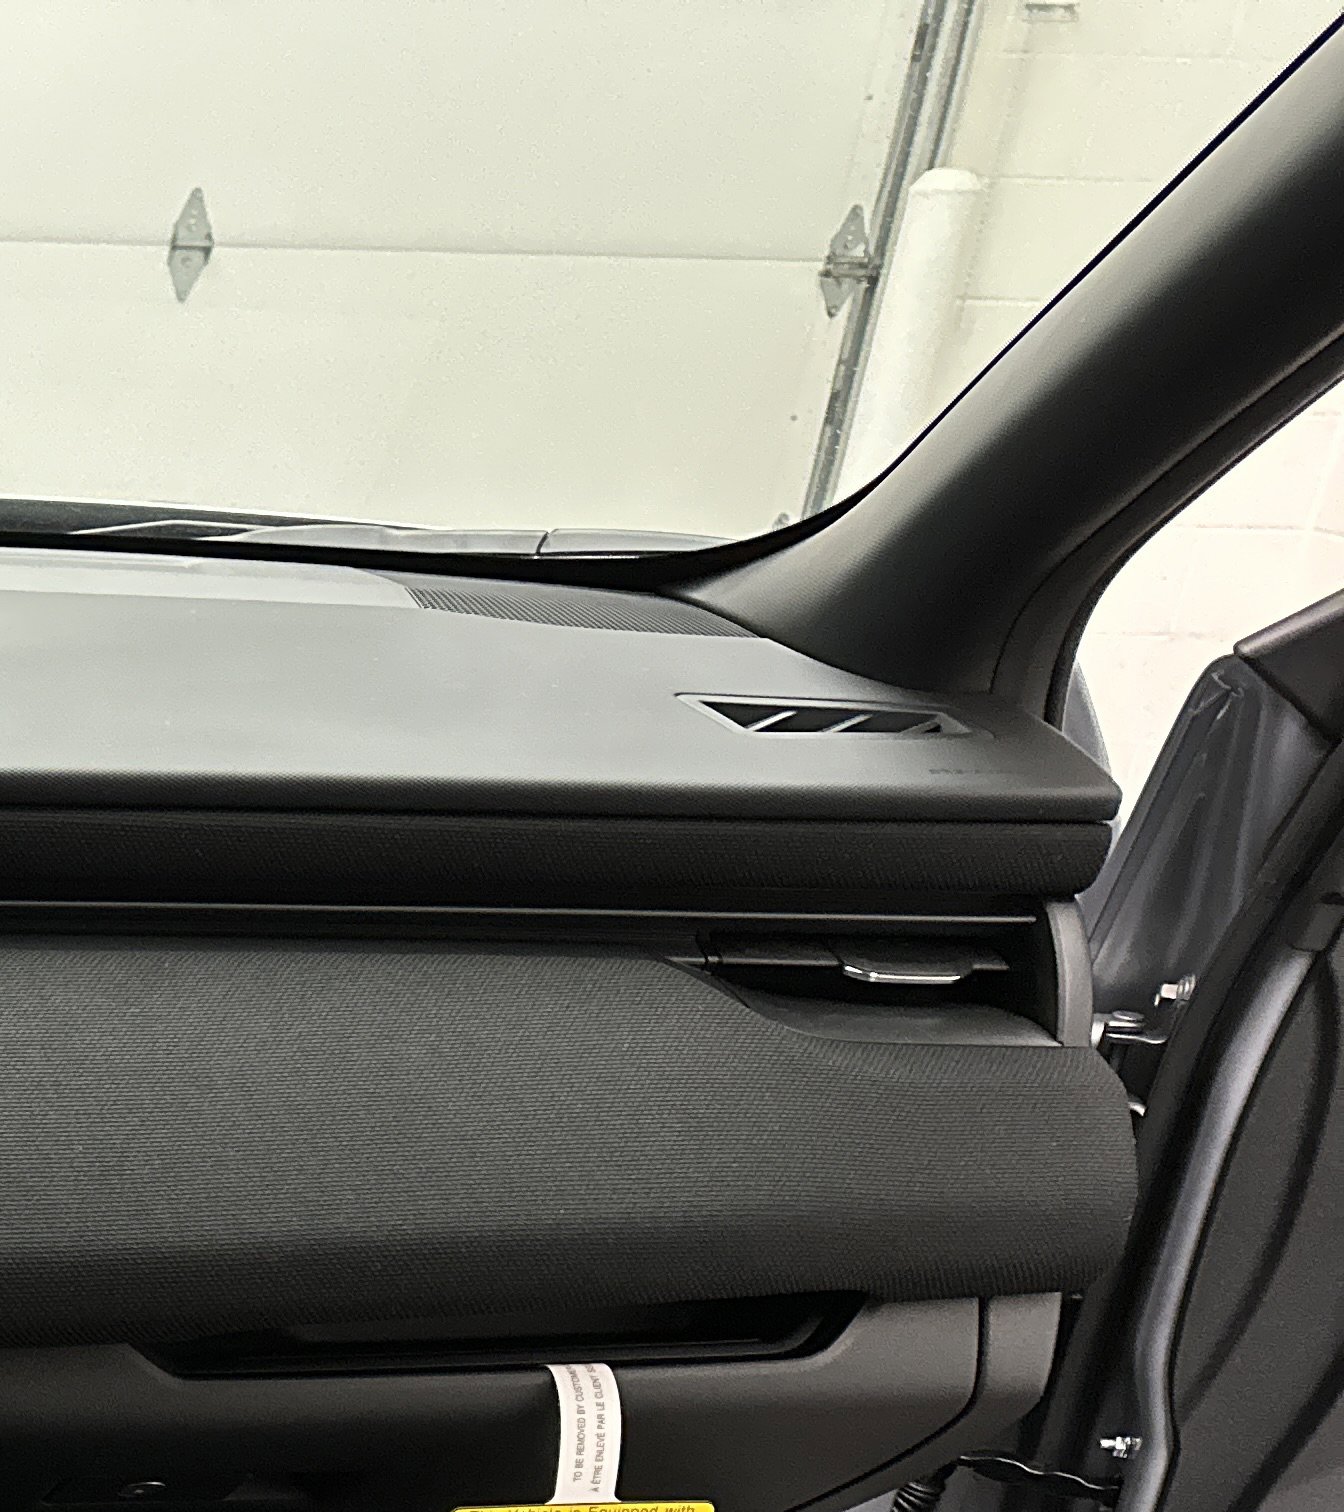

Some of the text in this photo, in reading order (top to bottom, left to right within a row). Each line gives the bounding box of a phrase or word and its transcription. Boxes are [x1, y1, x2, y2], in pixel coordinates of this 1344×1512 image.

[577, 1404, 586, 1415] BY
[596, 1401, 605, 1411] LE
[597, 1413, 605, 1429] PAR
[576, 1417, 586, 1455] REMOVED
[595, 1432, 605, 1462] ENLEVÉ
[575, 1458, 584, 1469] BE
[573, 1471, 583, 1482] TO
